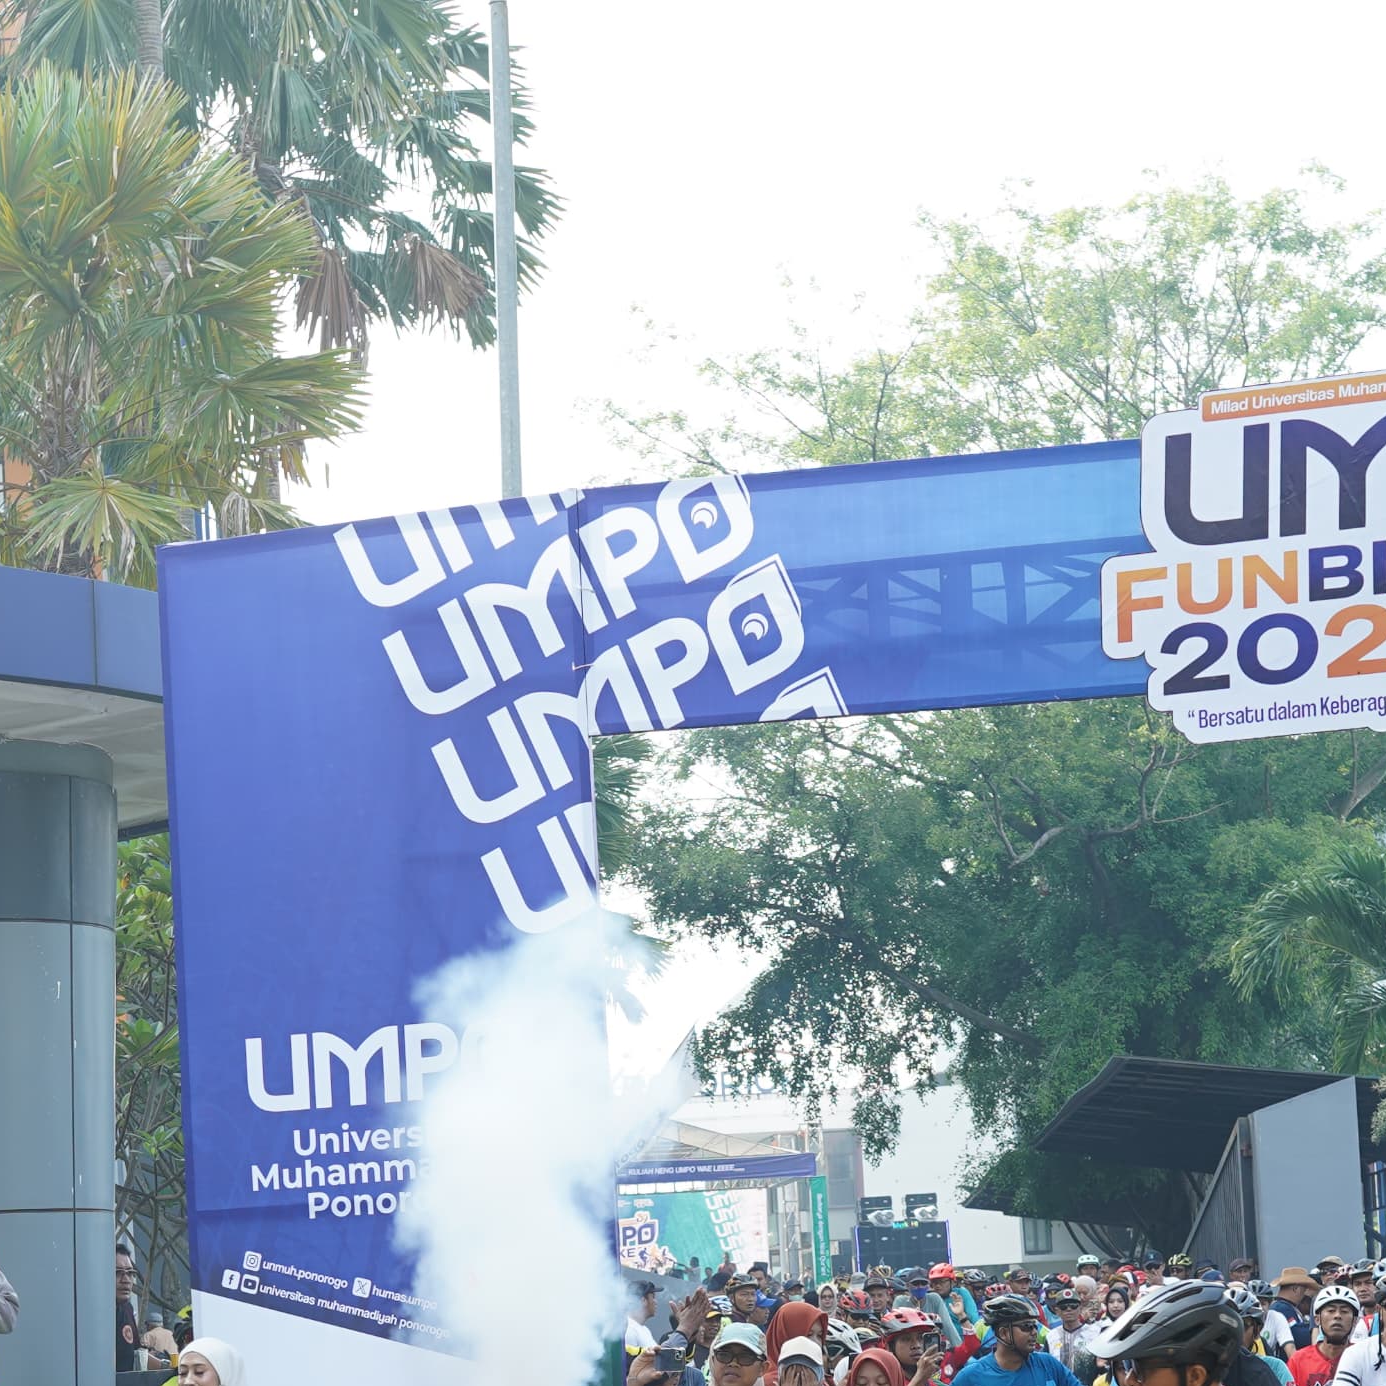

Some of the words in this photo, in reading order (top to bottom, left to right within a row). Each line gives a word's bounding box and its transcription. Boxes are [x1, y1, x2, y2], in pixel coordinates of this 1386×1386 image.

[1211, 397, 1248, 415] Milad
[1252, 387, 1335, 410] Universitas
[382, 473, 754, 715] UMPO
[1268, 700, 1317, 720] dalam
[245, 1022, 490, 1112] UMP
[293, 1123, 425, 1157] Univers
[263, 1260, 348, 1290] unmuh.ponorogo
[260, 1283, 316, 1306] universitas
[317, 1297, 398, 1325] muhammadiyah
